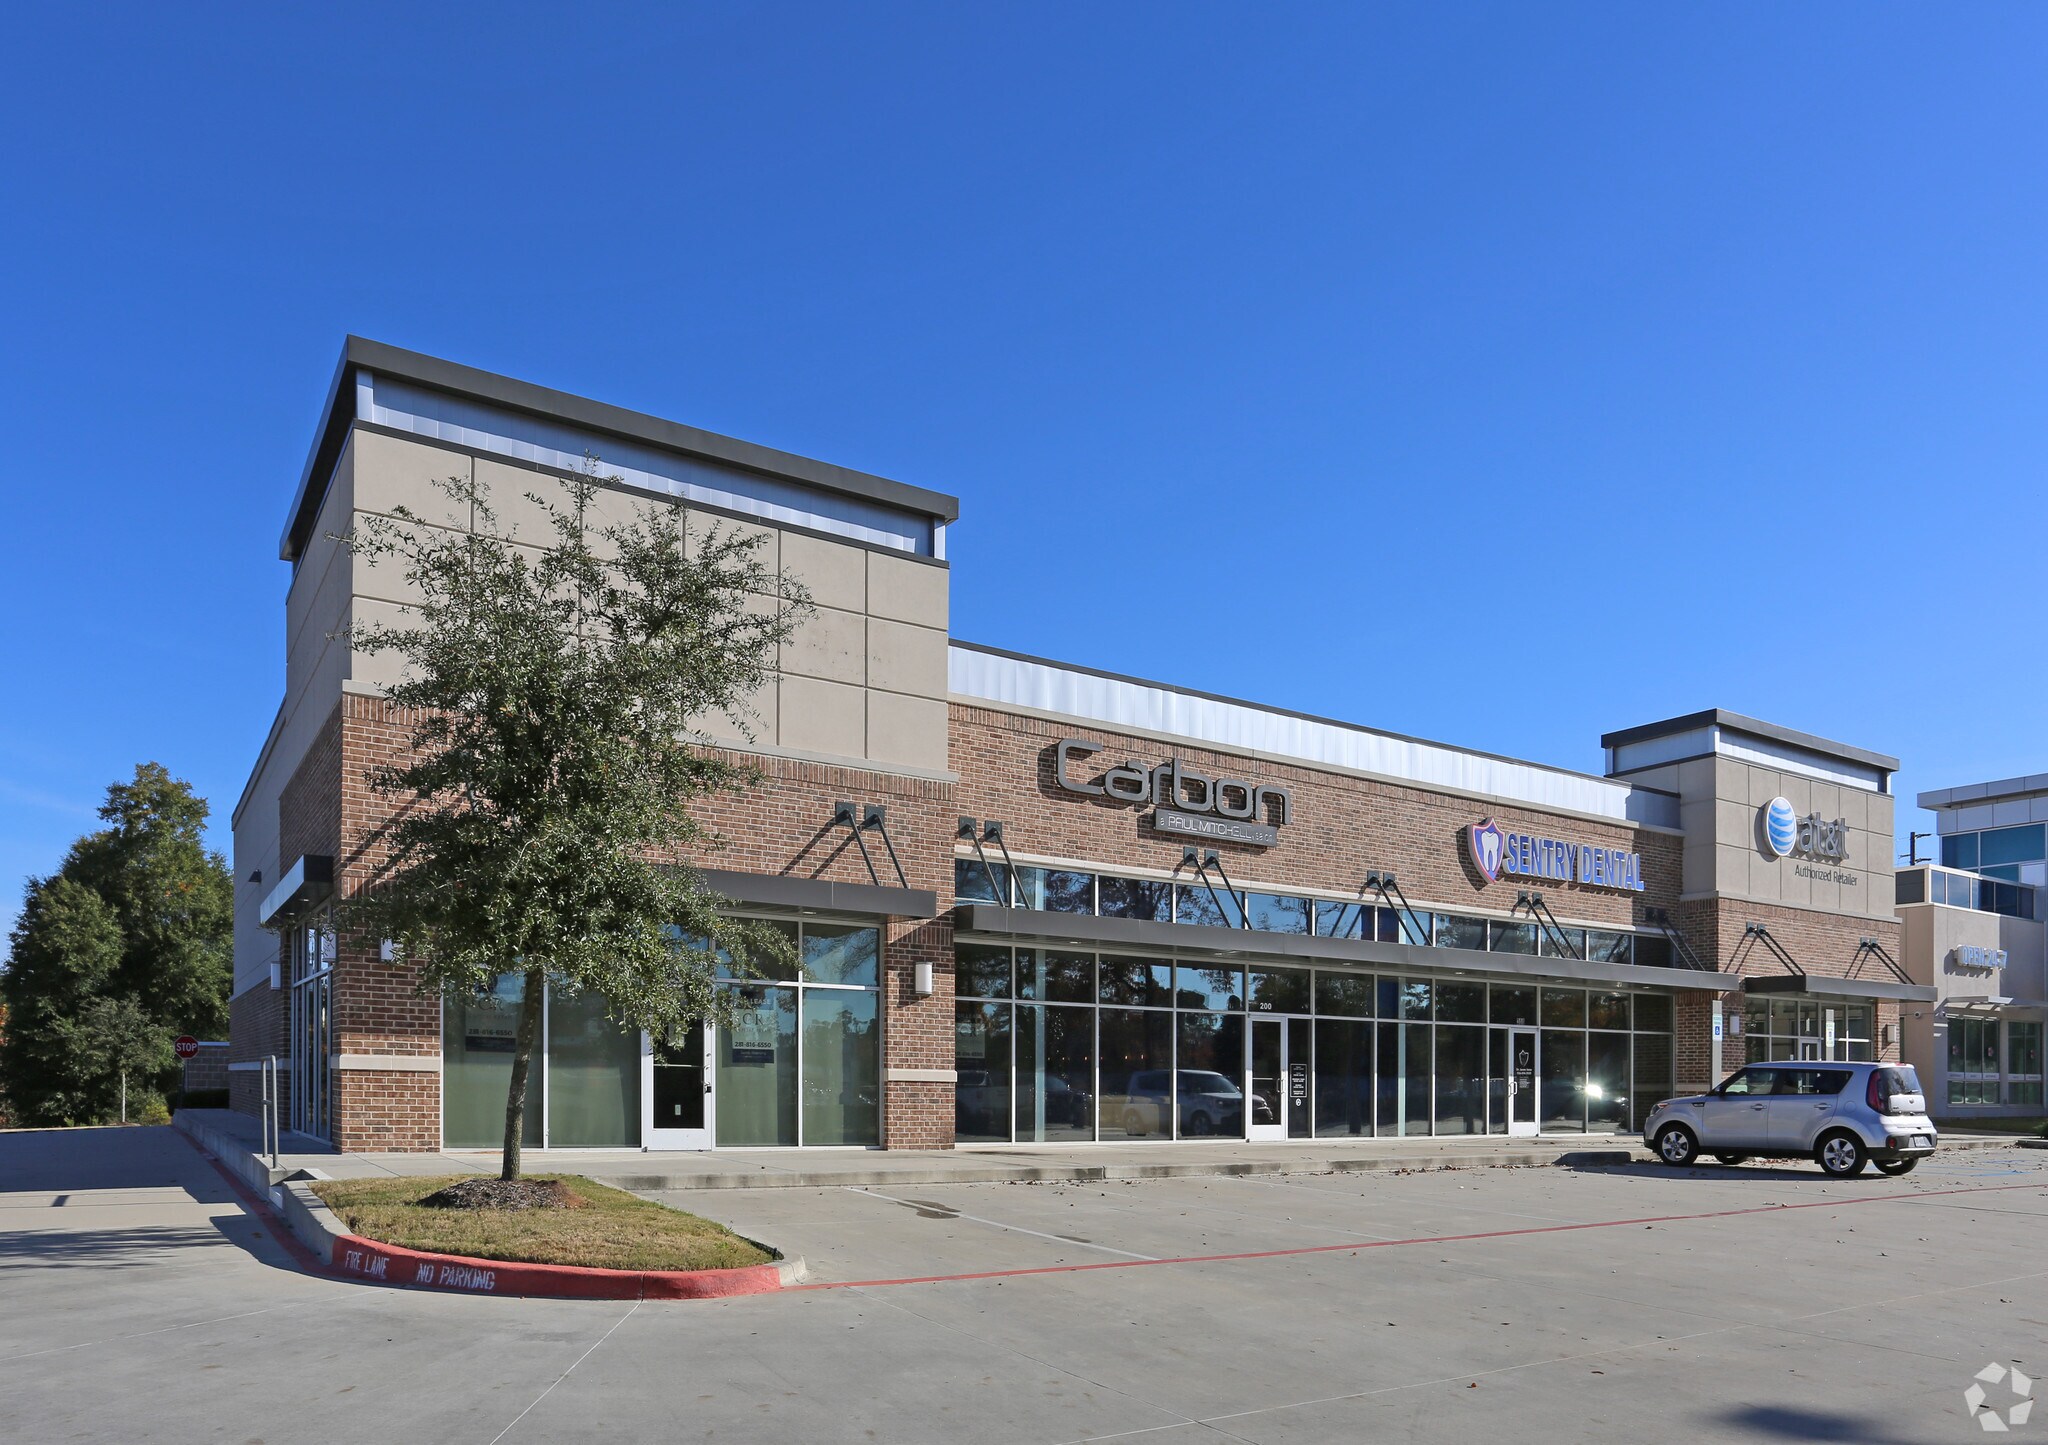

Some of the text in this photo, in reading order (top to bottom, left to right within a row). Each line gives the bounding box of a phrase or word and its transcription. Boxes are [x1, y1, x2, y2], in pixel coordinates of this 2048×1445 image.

[1056, 738, 1291, 825] Carbon
[1168, 815, 1198, 831] PAUL
[1200, 820, 1252, 839] MITCHELL
[1799, 812, 1849, 860] at&t
[1504, 832, 1645, 892] SENTRY DENTAL
[1795, 864, 1858, 886] Authorized Retailer
[1260, 1002, 1272, 1010] 200
[176, 1042, 198, 1052] STOP
[345, 1250, 390, 1279] FIRE LANE
[416, 1263, 496, 1290] NO PARKING
